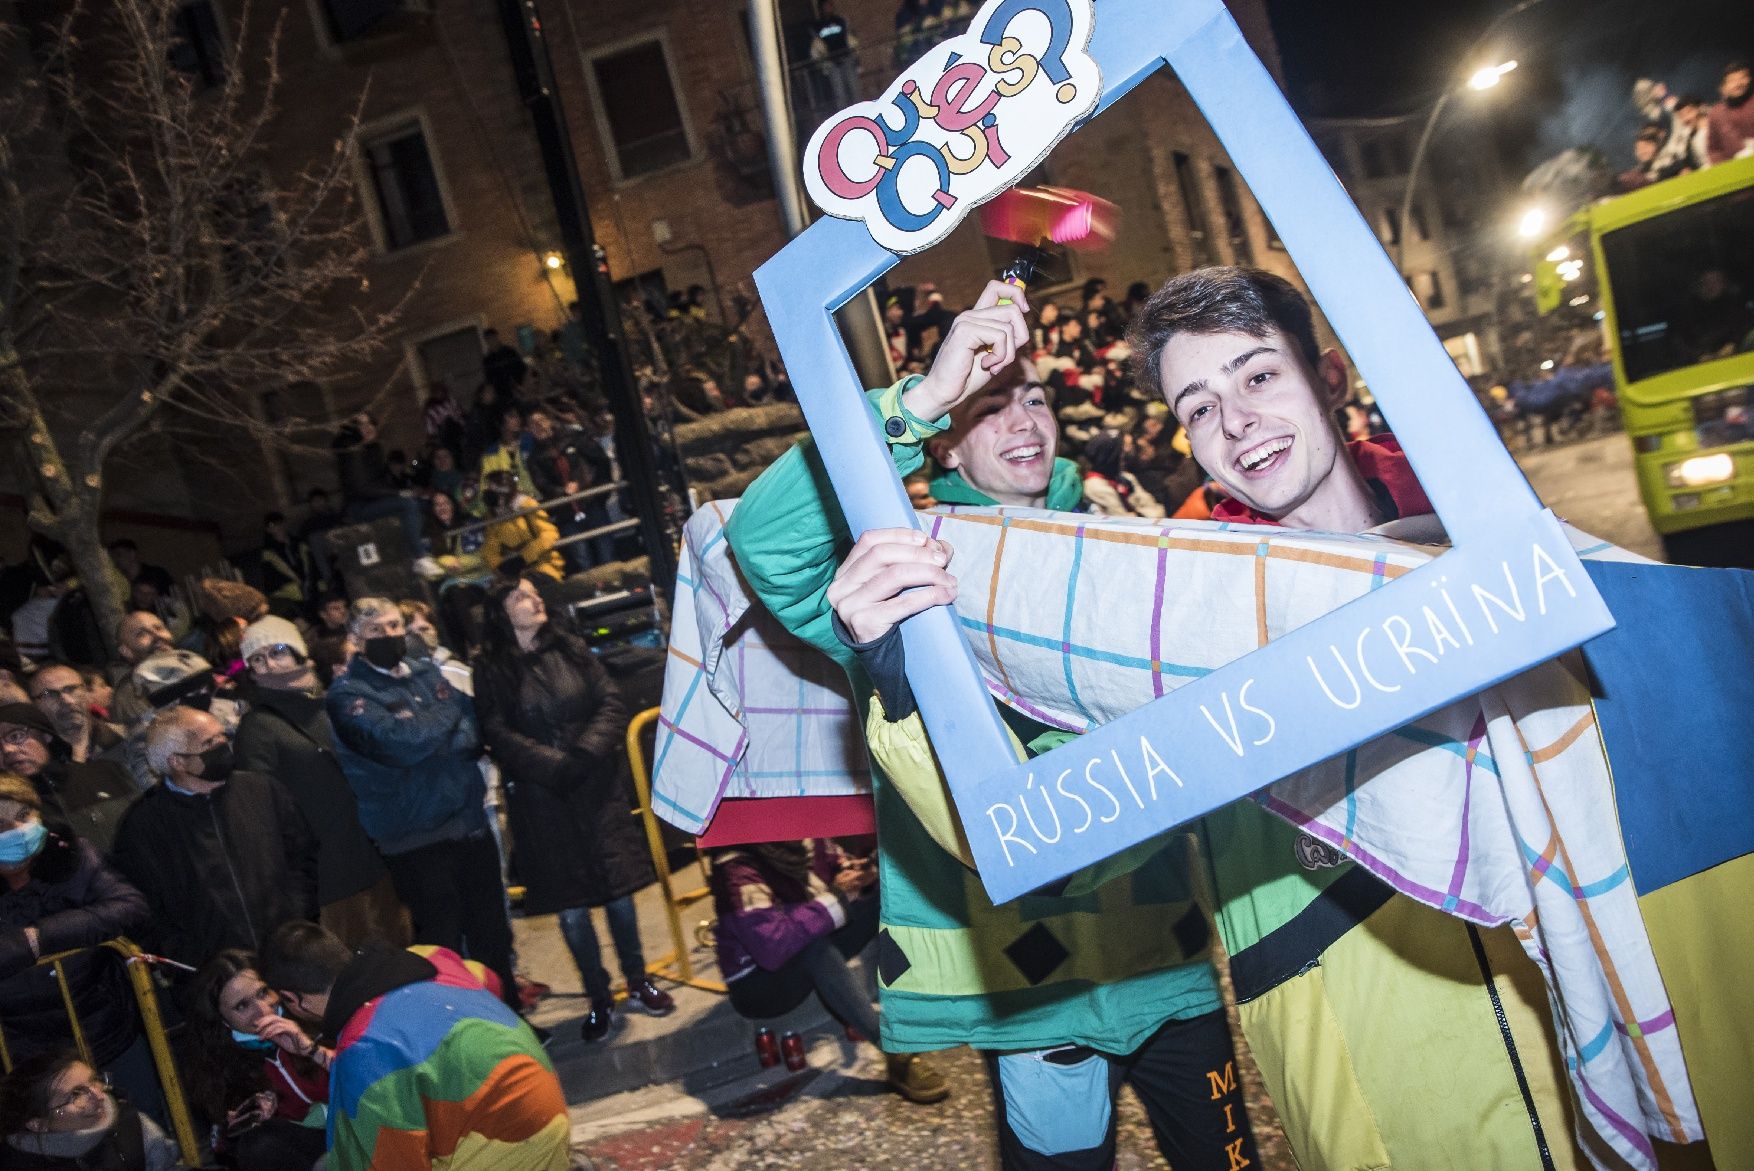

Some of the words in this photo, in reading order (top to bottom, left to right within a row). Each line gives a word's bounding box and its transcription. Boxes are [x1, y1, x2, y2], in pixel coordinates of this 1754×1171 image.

[876, 113, 1011, 232] Qui
[985, 735, 1184, 868] RÚSSIA
[1200, 678, 1276, 759] VS
[1306, 542, 1577, 711] UCRAÏNA
